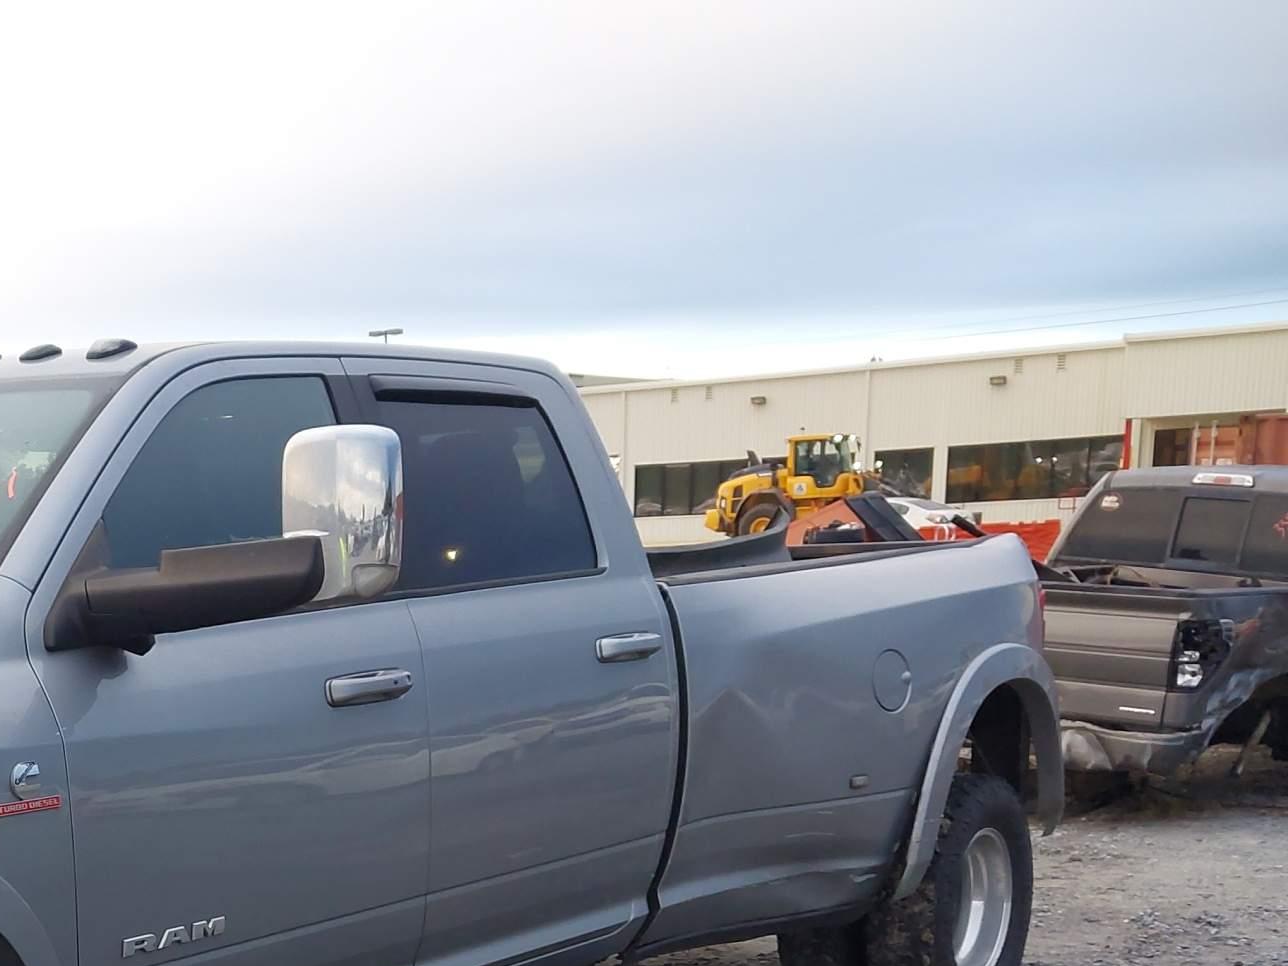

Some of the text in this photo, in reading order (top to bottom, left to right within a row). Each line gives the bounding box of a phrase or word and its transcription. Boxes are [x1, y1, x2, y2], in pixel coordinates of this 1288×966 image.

[0, 798, 59, 814] TURBO DIESEL
[122, 915, 226, 958] RAM
